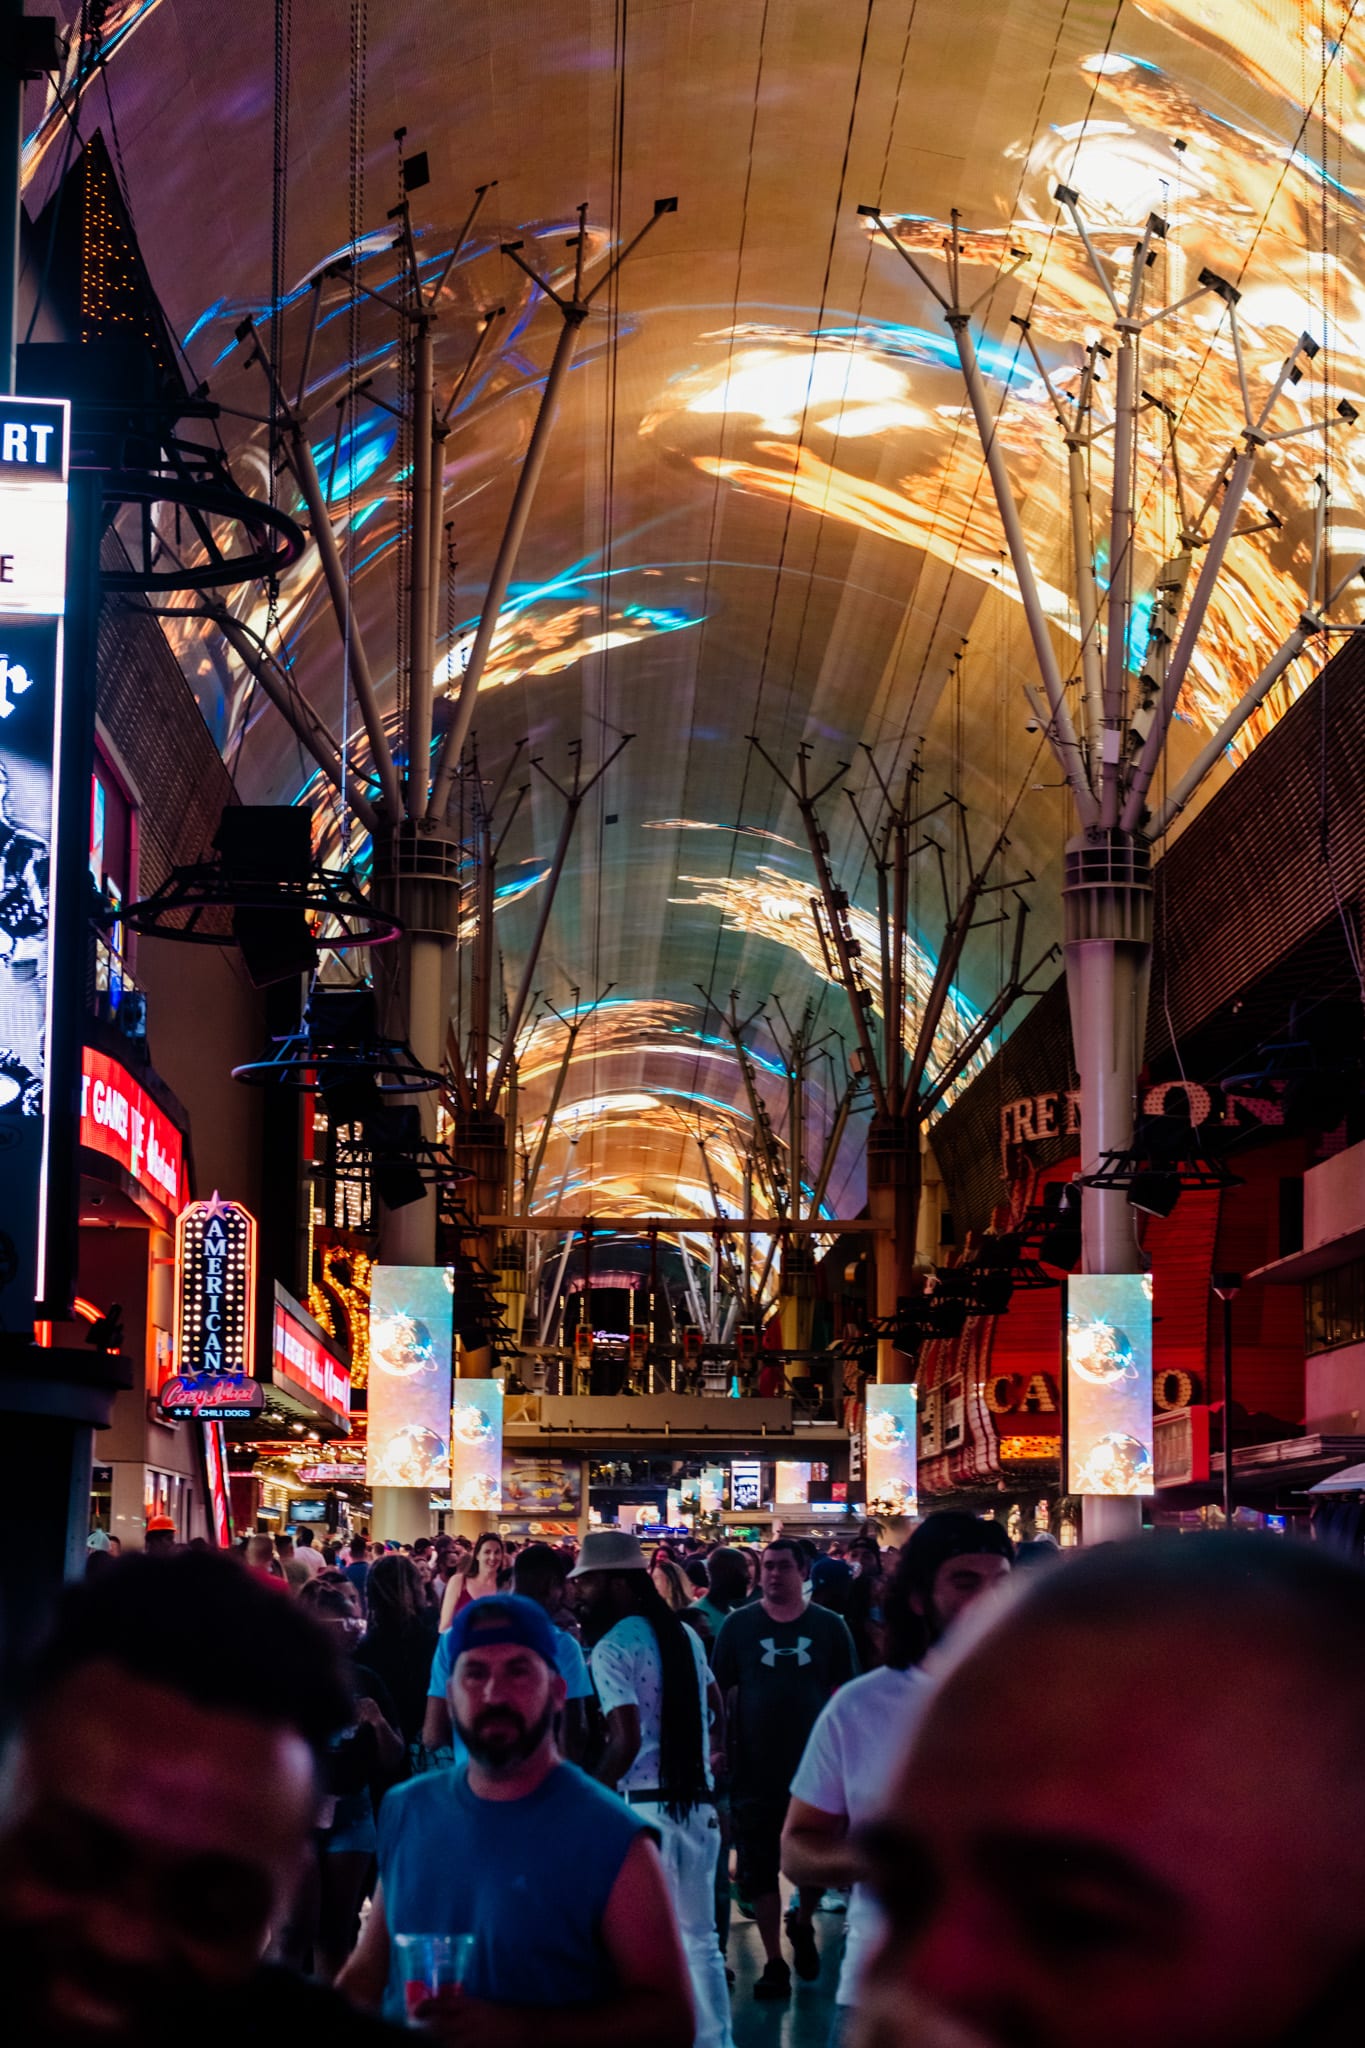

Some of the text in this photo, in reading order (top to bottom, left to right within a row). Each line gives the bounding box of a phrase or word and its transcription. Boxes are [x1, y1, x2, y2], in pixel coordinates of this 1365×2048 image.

[2, 423, 54, 463] RT
[203, 1219, 227, 1370] AMERICAN
[198, 1409, 251, 1417] CHILI DOGS
